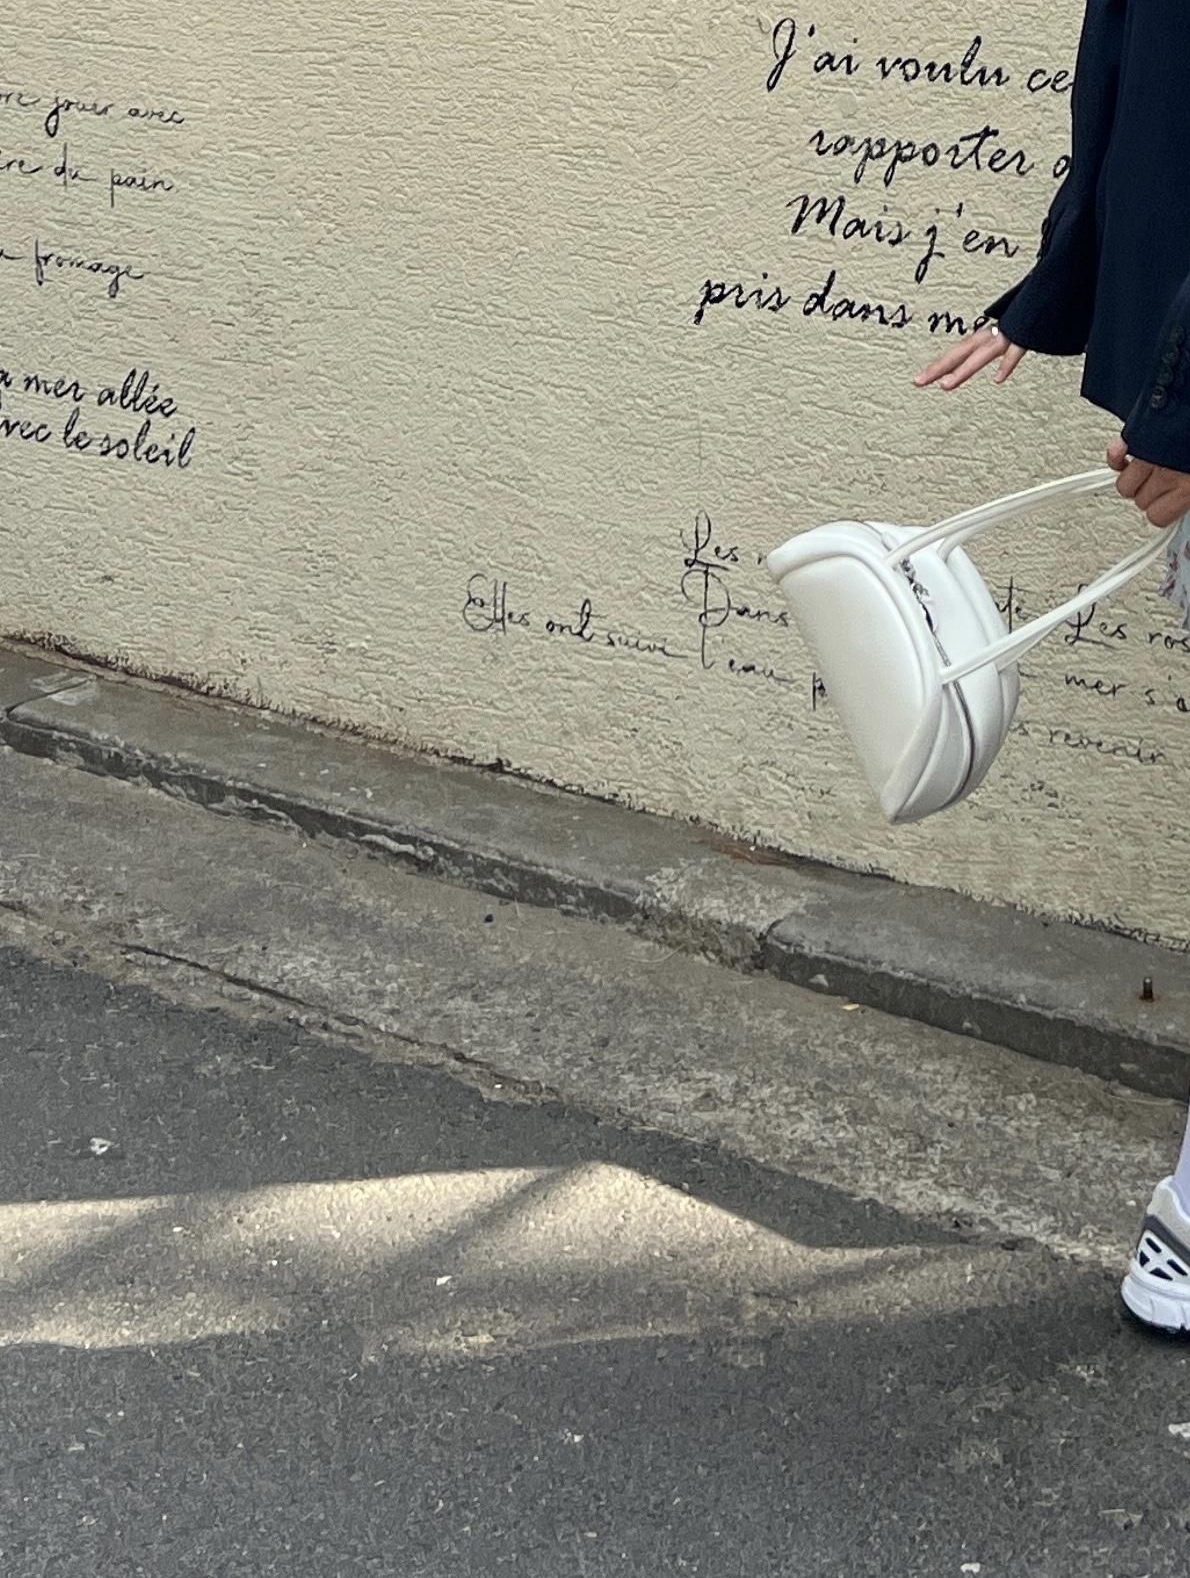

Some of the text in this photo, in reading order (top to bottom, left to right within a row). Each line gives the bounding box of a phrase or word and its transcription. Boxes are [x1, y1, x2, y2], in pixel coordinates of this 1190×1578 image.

[766, 17, 860, 91] J'ai
[876, 35, 1010, 87] voulu
[809, 125, 1036, 187] rapporter
[110, 168, 175, 209] pain
[787, 194, 912, 247] Mais
[35, 238, 145, 299] fromage
[694, 272, 792, 326] pris
[803, 270, 913, 328] dans
[23, 373, 86, 403] mer
[98, 367, 178, 420] allée
[0, 406, 197, 469] vec le soleil
